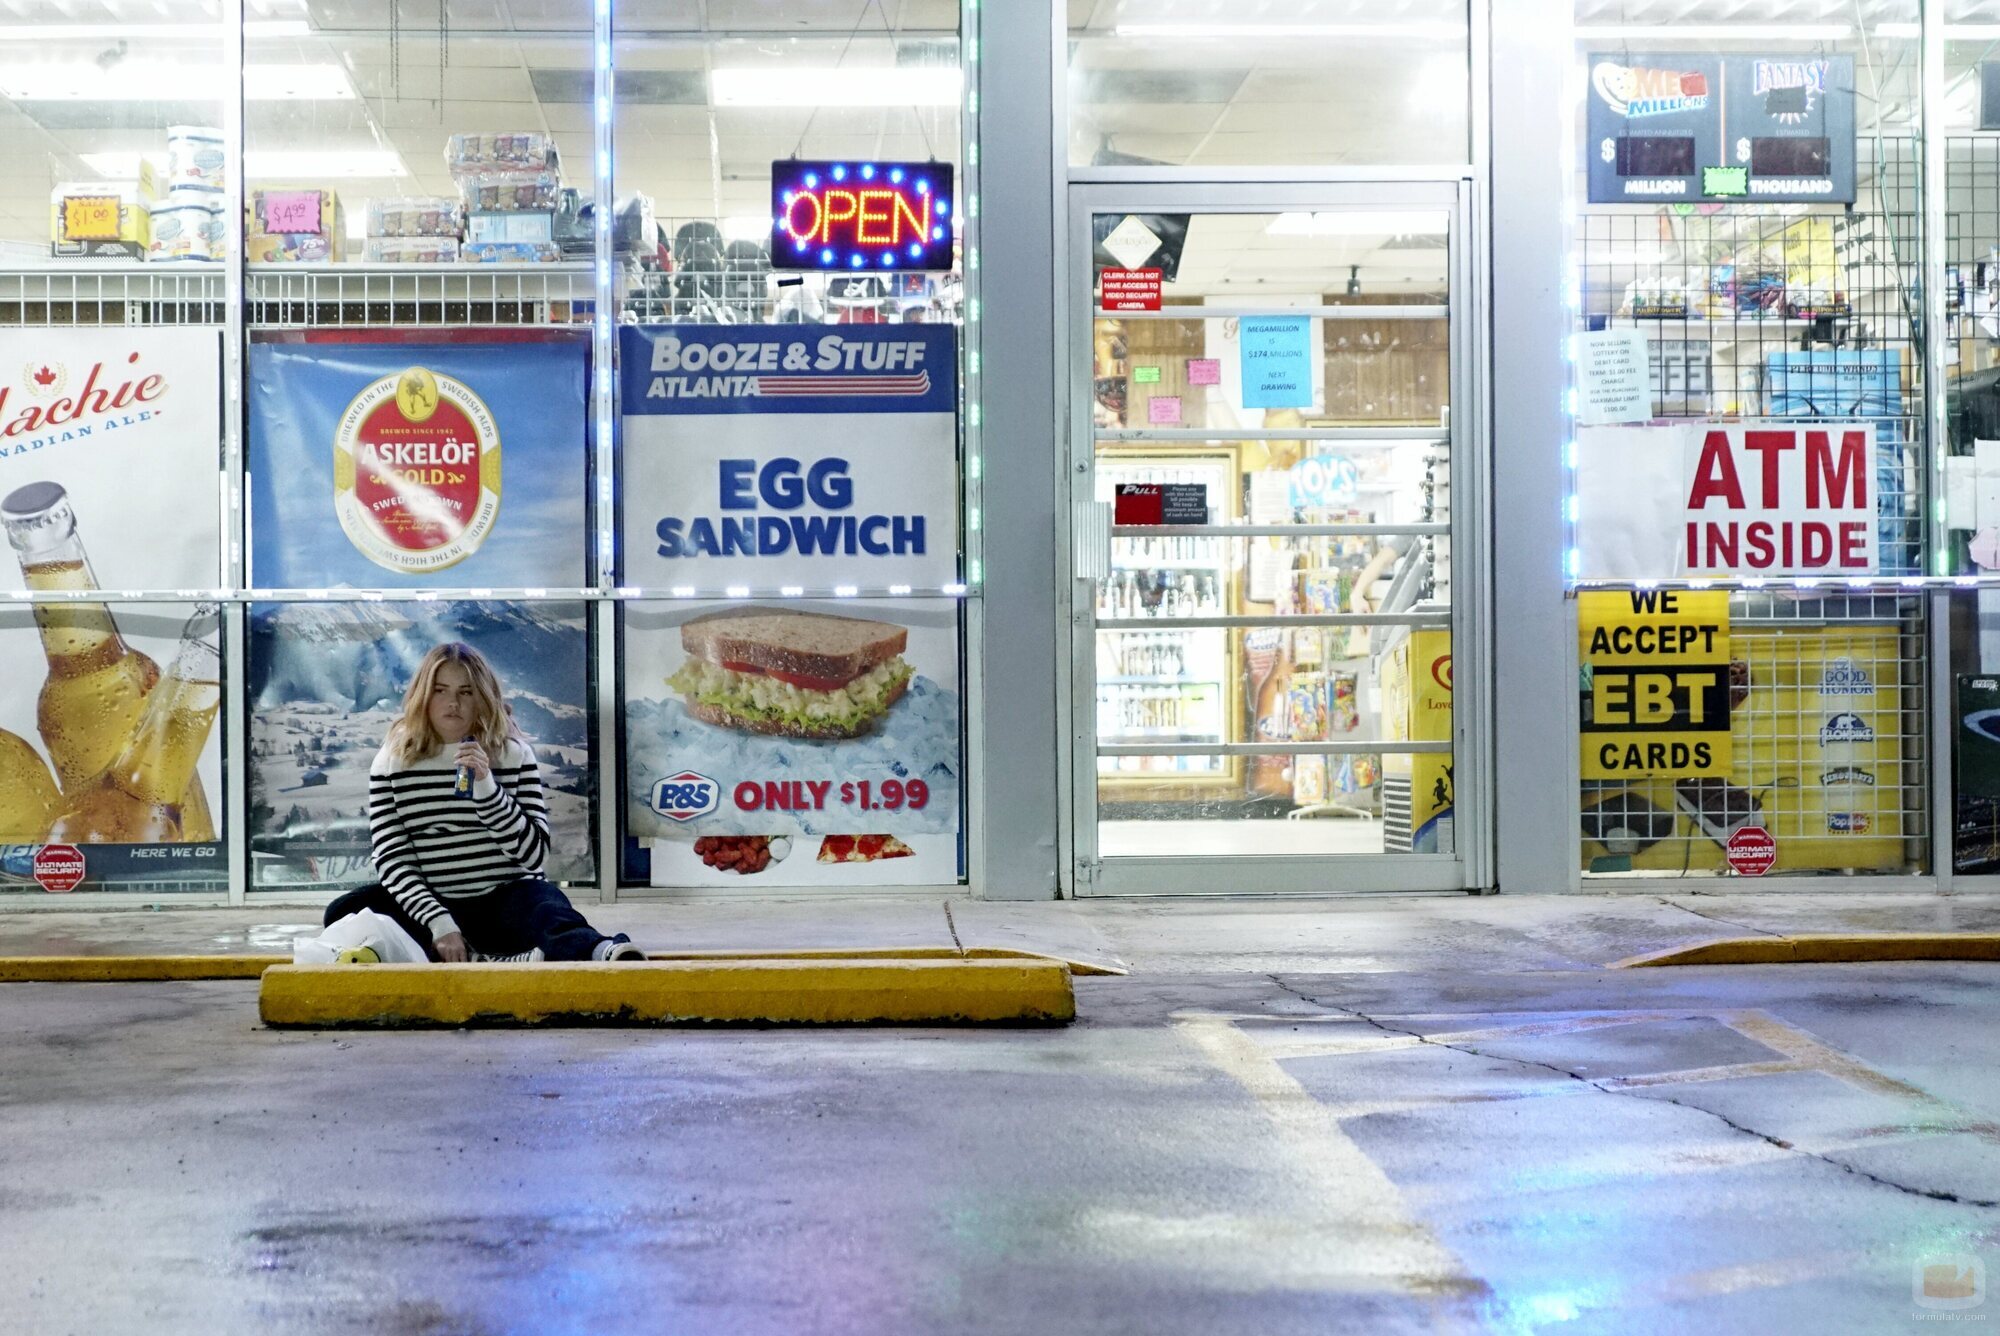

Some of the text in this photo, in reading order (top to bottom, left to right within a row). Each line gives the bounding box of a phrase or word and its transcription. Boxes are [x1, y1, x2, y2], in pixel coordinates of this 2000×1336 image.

[1753, 60, 1829, 95] FANTASY
[1627, 96, 1708, 117] MILLIONS
[1601, 137, 1616, 163] $
[1736, 137, 1751, 163] $
[1624, 180, 1686, 194] MILLION
[1749, 180, 1833, 194] THOUSAND
[786, 190, 930, 243] OPEN
[1247, 325, 1300, 333] MEGAMILLION
[1268, 371, 1287, 379] NEXT
[647, 376, 761, 398] ATLANTA
[1261, 383, 1297, 391] DRAWING
[104, 410, 152, 432] ALE
[363, 391, 376, 405] IN
[376, 380, 394, 394] THE
[441, 381, 481, 417] SWEDISH
[477, 412, 494, 439] ALPS
[361, 437, 476, 465] ASKELÖF
[391, 468, 446, 486] GOLD
[1290, 458, 1357, 499] TOYS
[1687, 430, 1868, 510] ATM
[719, 456, 854, 510] EGG
[1121, 485, 1159, 495] PULL
[656, 514, 927, 558] SANDWICH
[1686, 521, 1869, 569] INSIDE
[401, 555, 428, 567] HIGH
[430, 552, 450, 566] THE
[1630, 590, 1679, 614] WE
[1590, 625, 1719, 655] ACCEPT
[1819, 682, 1874, 694] HUMOR
[1825, 671, 1867, 682] GOOD
[1593, 672, 1717, 725] EBT
[1600, 741, 1712, 770] CARDS
[733, 778, 930, 812] ONLY $1.99
[130, 847, 218, 858] HERE WE GO
[36, 867, 82, 875] SECURITY
